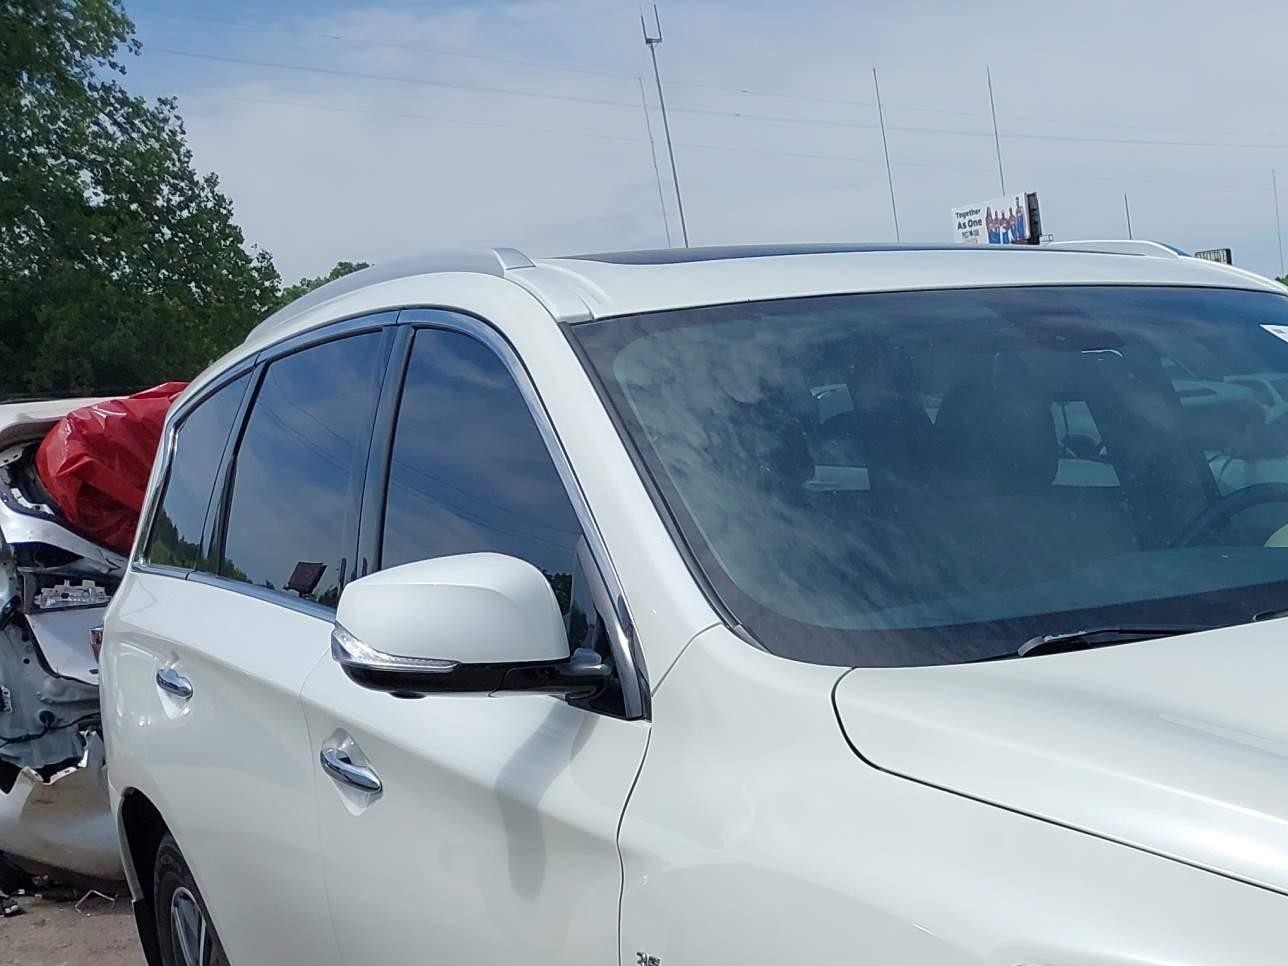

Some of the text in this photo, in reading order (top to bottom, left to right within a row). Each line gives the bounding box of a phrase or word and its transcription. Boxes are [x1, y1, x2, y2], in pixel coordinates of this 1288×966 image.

[955, 208, 981, 218] Together
[957, 218, 983, 231] As One
